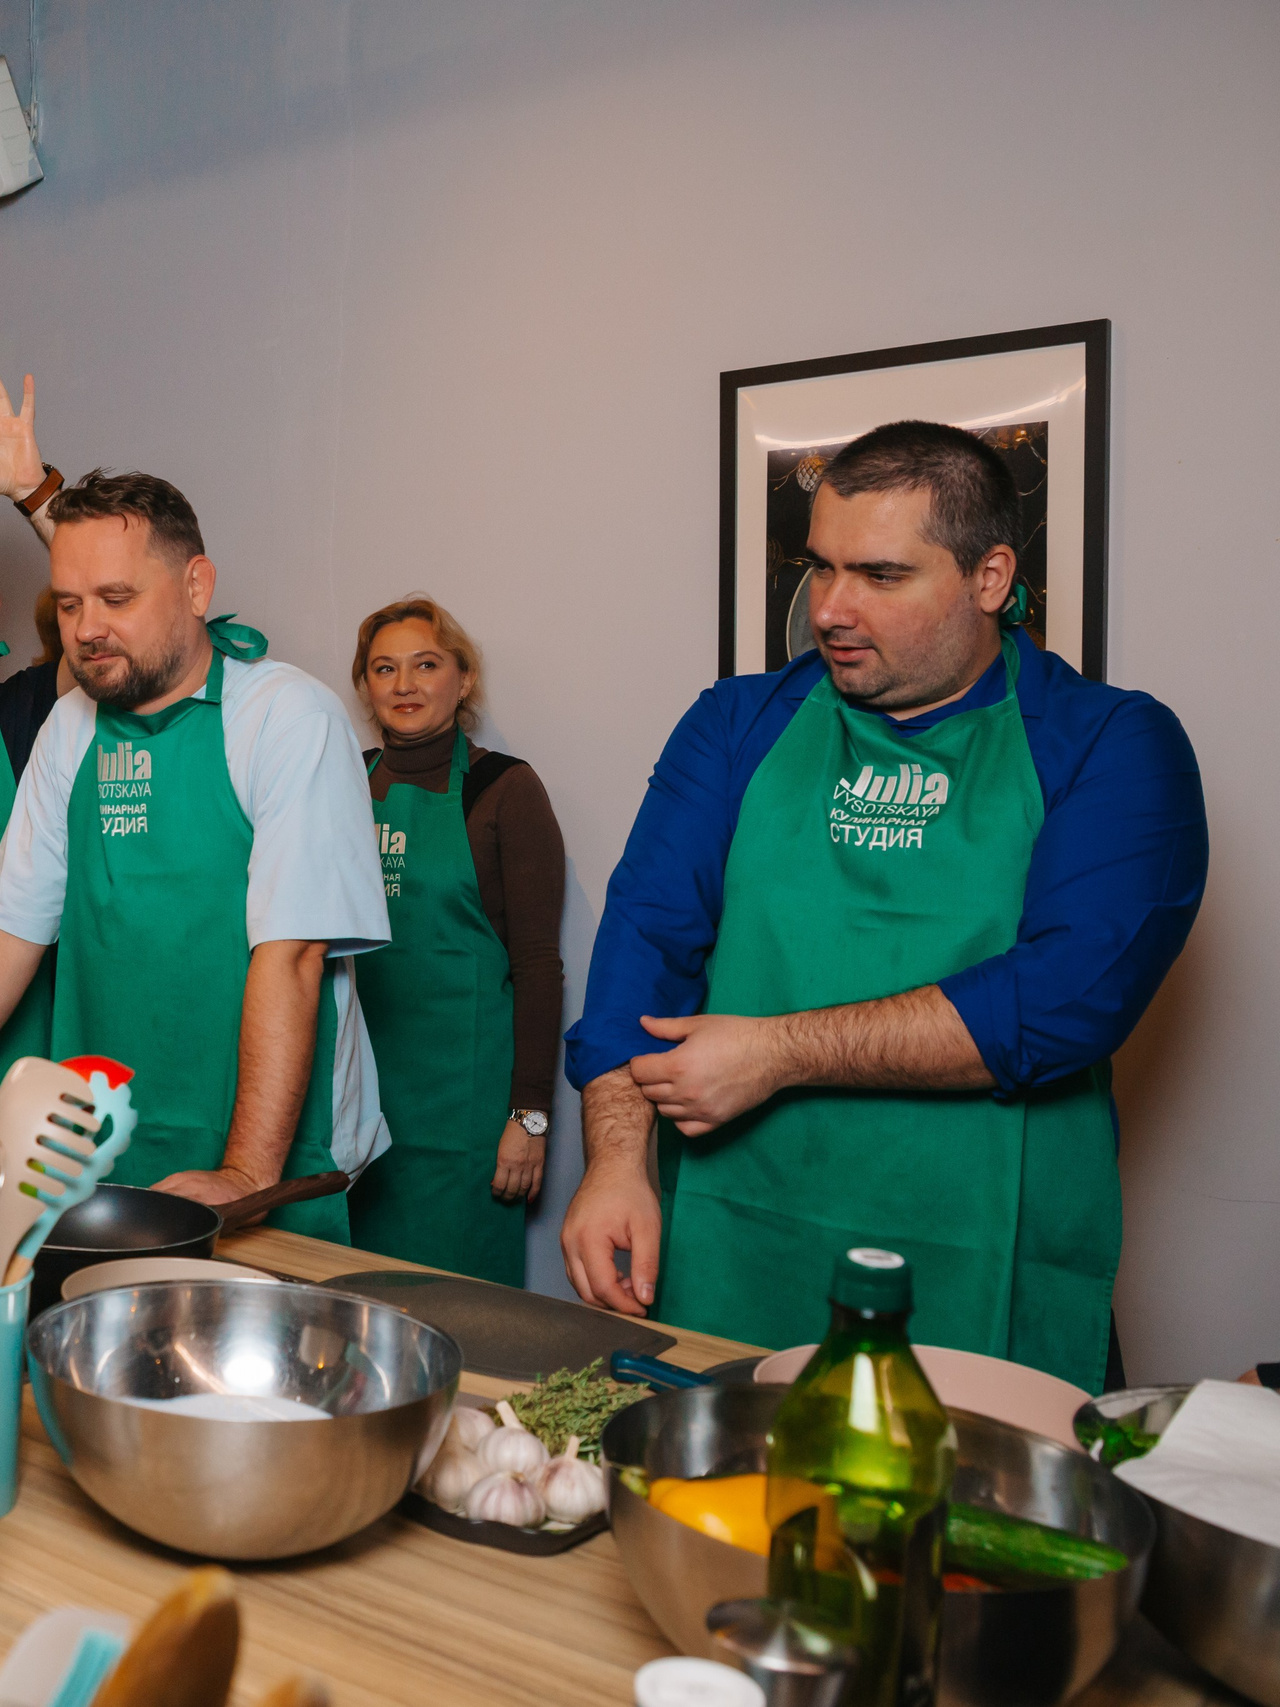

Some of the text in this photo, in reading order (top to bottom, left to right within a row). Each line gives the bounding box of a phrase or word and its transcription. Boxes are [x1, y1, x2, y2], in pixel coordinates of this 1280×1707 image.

[839, 763, 949, 805] Julia
[833, 785, 940, 817] VYSOTSKAYA
[101, 816, 148, 837] УДИЯ
[830, 807, 927, 826] КУЛИНАРНАЯ
[830, 822, 923, 851] СТУДИЯ
